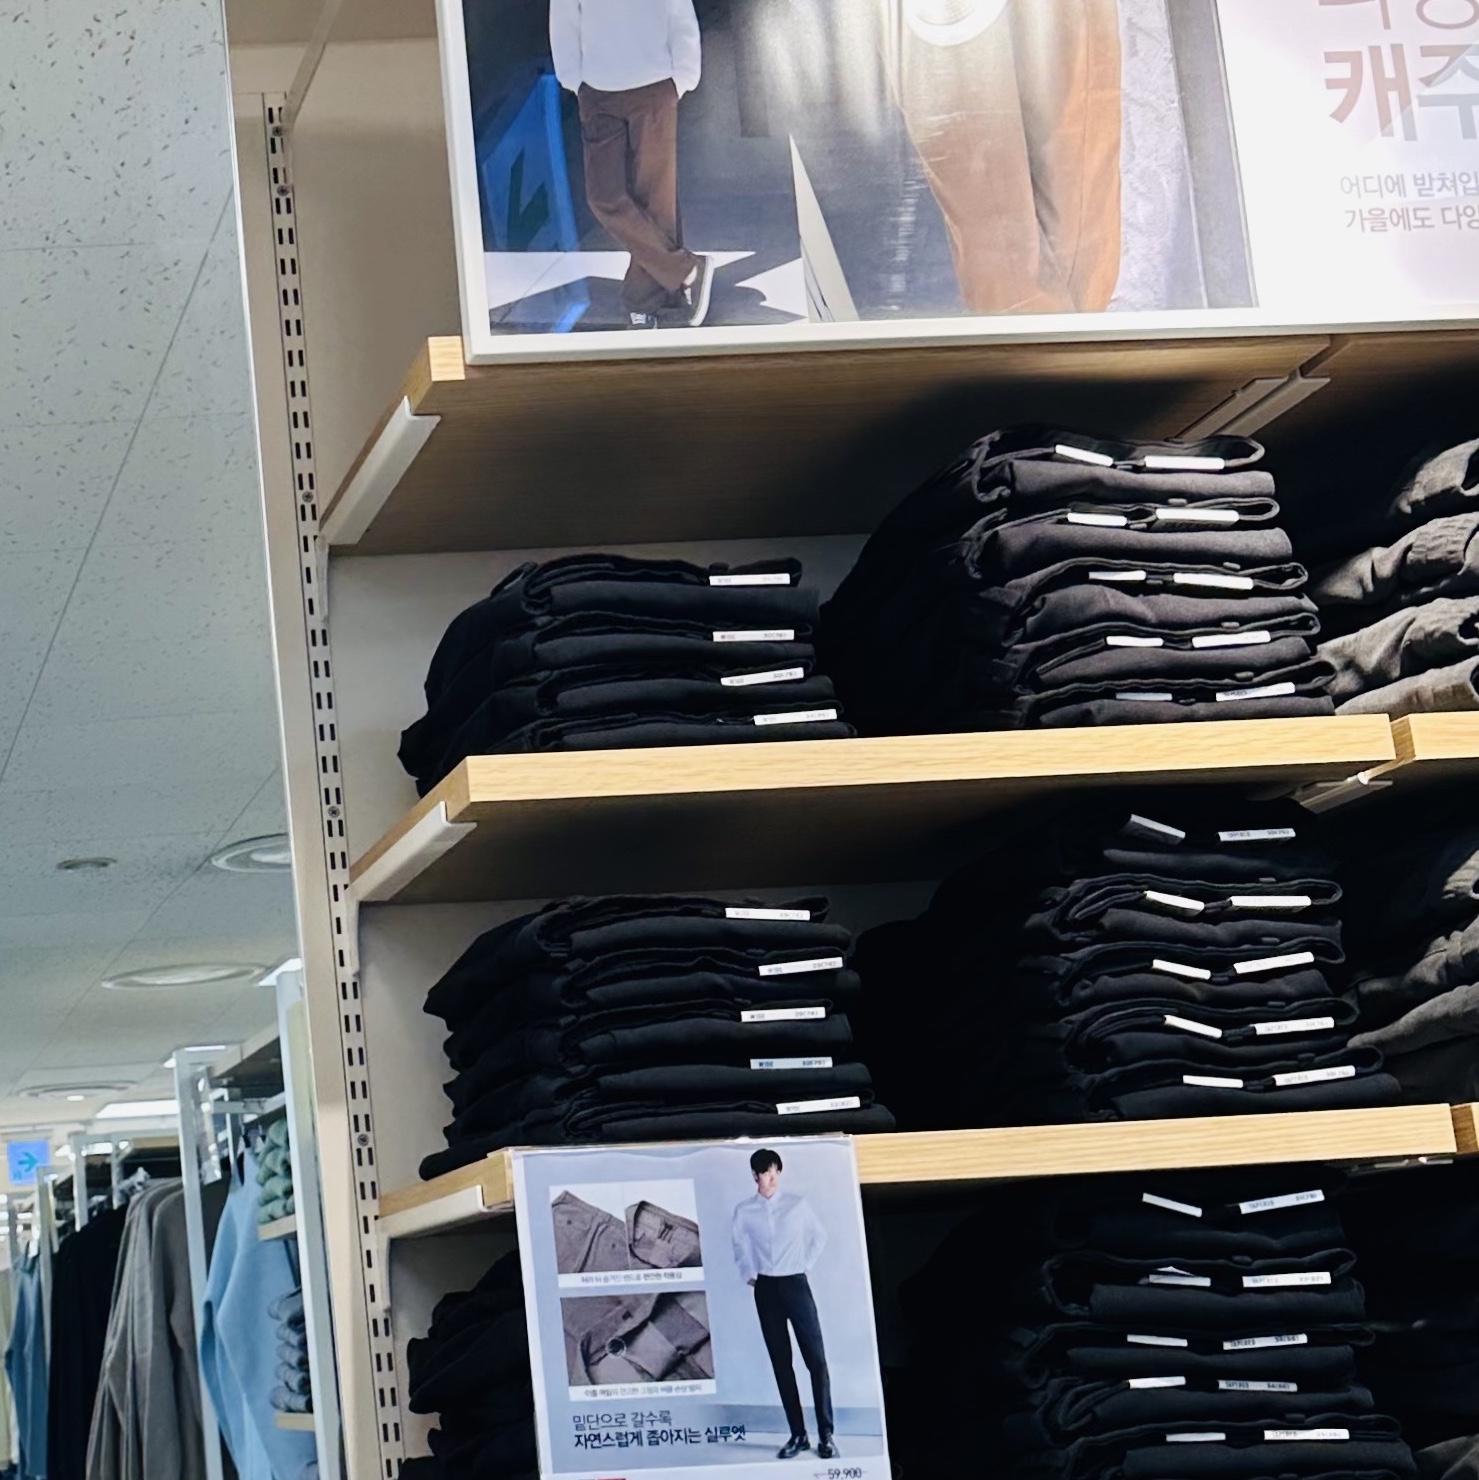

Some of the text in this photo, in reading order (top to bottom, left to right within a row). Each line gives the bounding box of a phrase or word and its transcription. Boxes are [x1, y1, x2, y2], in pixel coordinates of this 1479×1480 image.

[1340, 171, 1479, 199] 어디에 받쳐입
[1343, 207, 1435, 233] 가을에도
[573, 1410, 672, 1431] 밑단으로 갈수록
[574, 1424, 747, 1449] 자연스럽게 좁아지는 실루엣
[827, 1467, 862, 1480] 59,900
